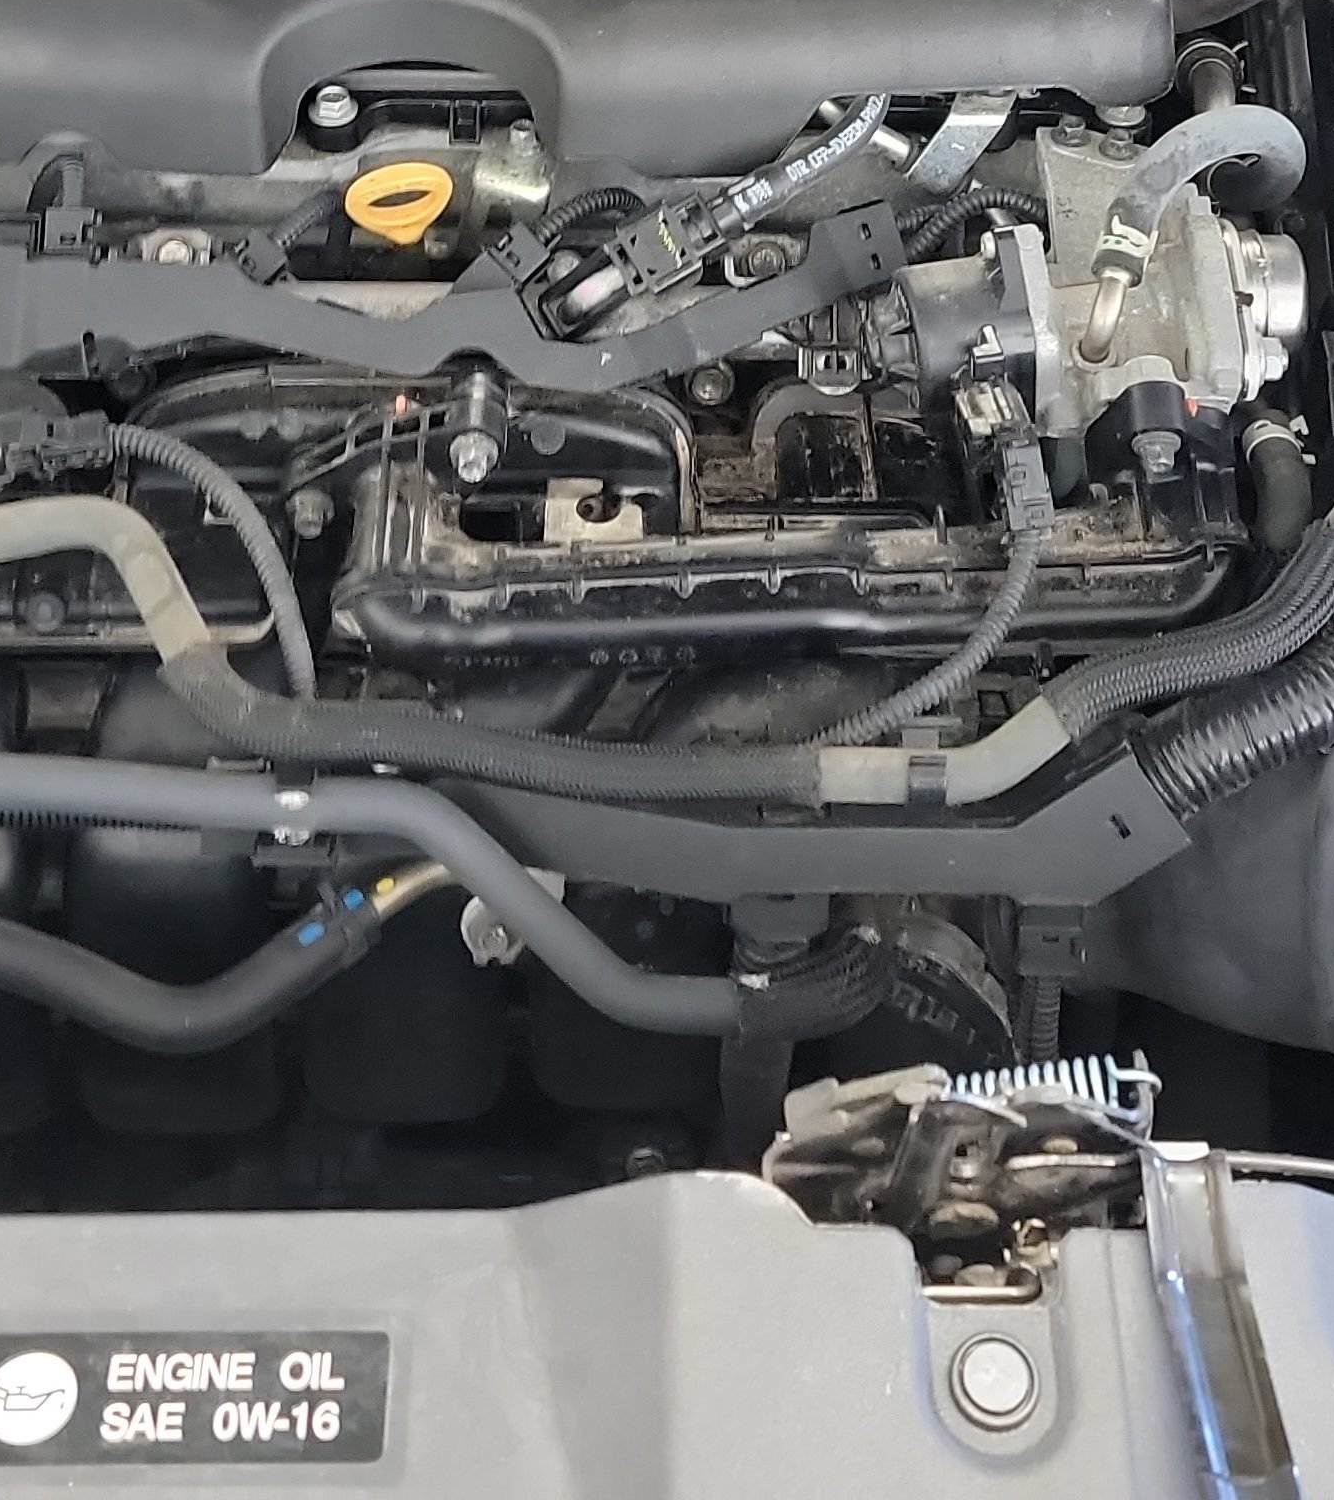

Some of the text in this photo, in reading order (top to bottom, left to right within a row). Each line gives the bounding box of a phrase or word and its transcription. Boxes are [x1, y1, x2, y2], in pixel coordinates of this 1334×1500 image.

[106, 1350, 346, 1393] ENGINE OIL
[98, 1400, 341, 1443] SAE 0W-16
